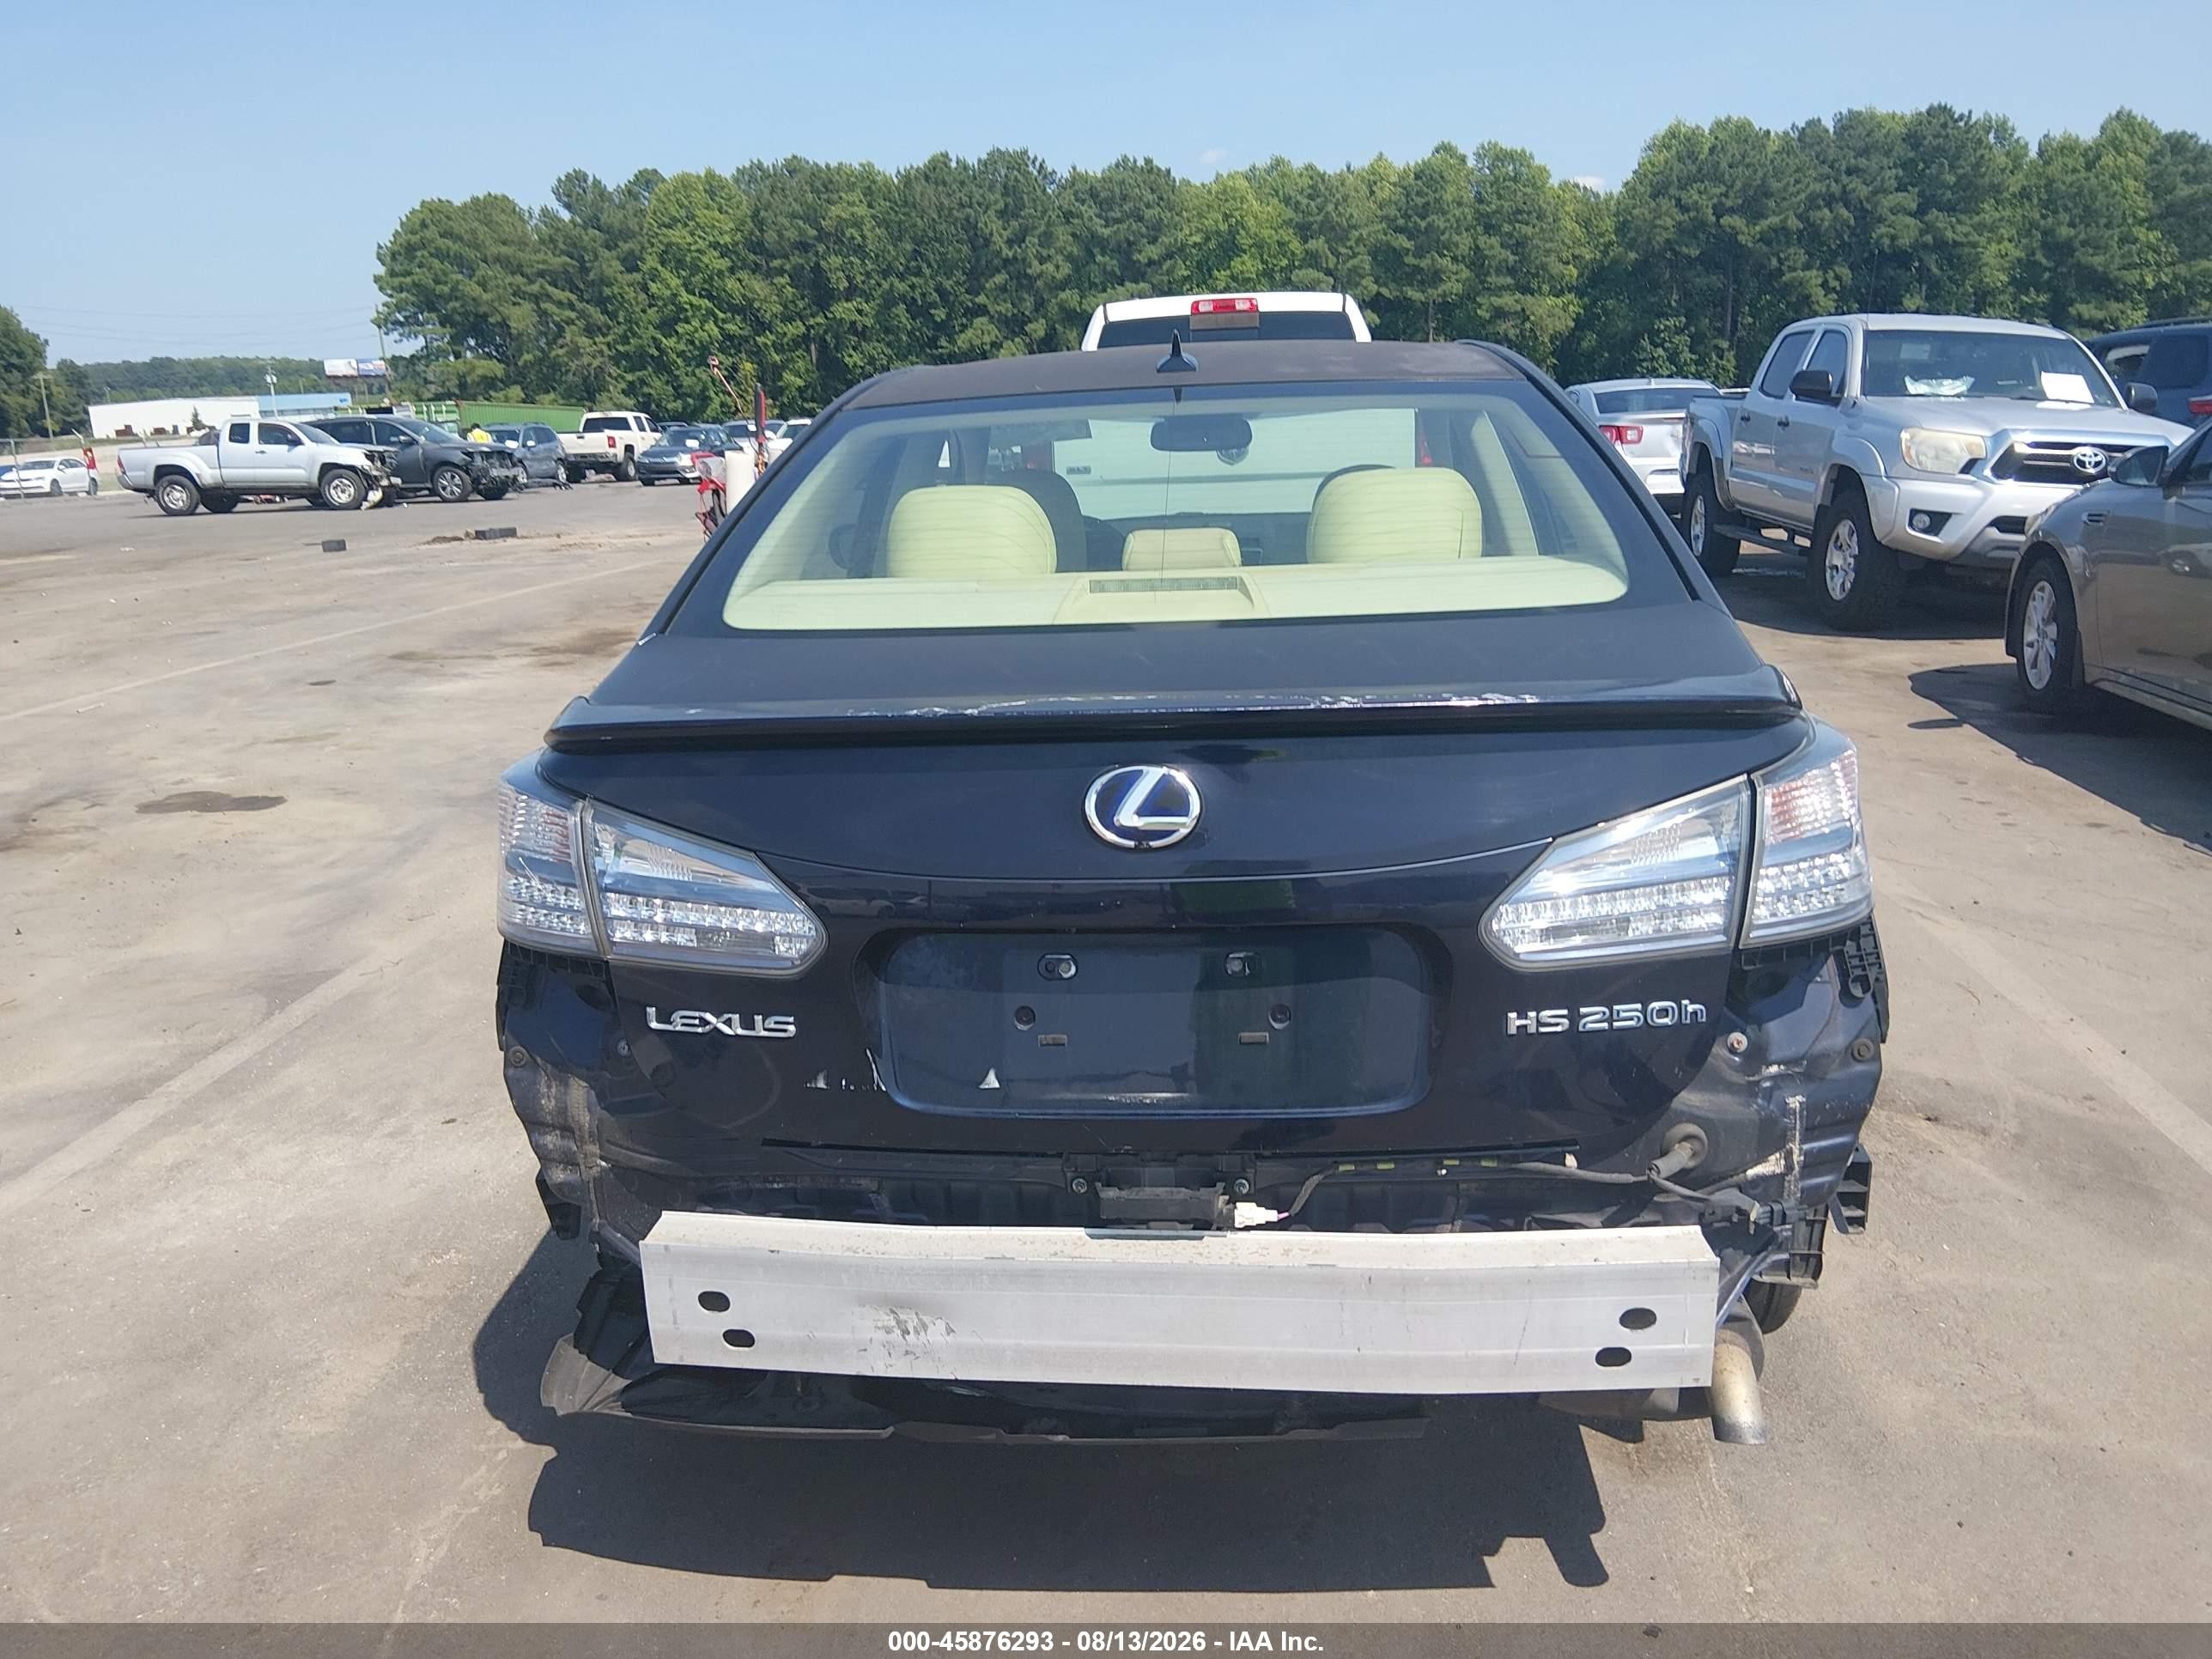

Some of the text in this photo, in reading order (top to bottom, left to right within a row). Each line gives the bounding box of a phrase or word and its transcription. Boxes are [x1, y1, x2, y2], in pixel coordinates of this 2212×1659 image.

[646, 1006, 797, 1038] LEXUS
[1507, 1000, 1707, 1036] HS 250h
